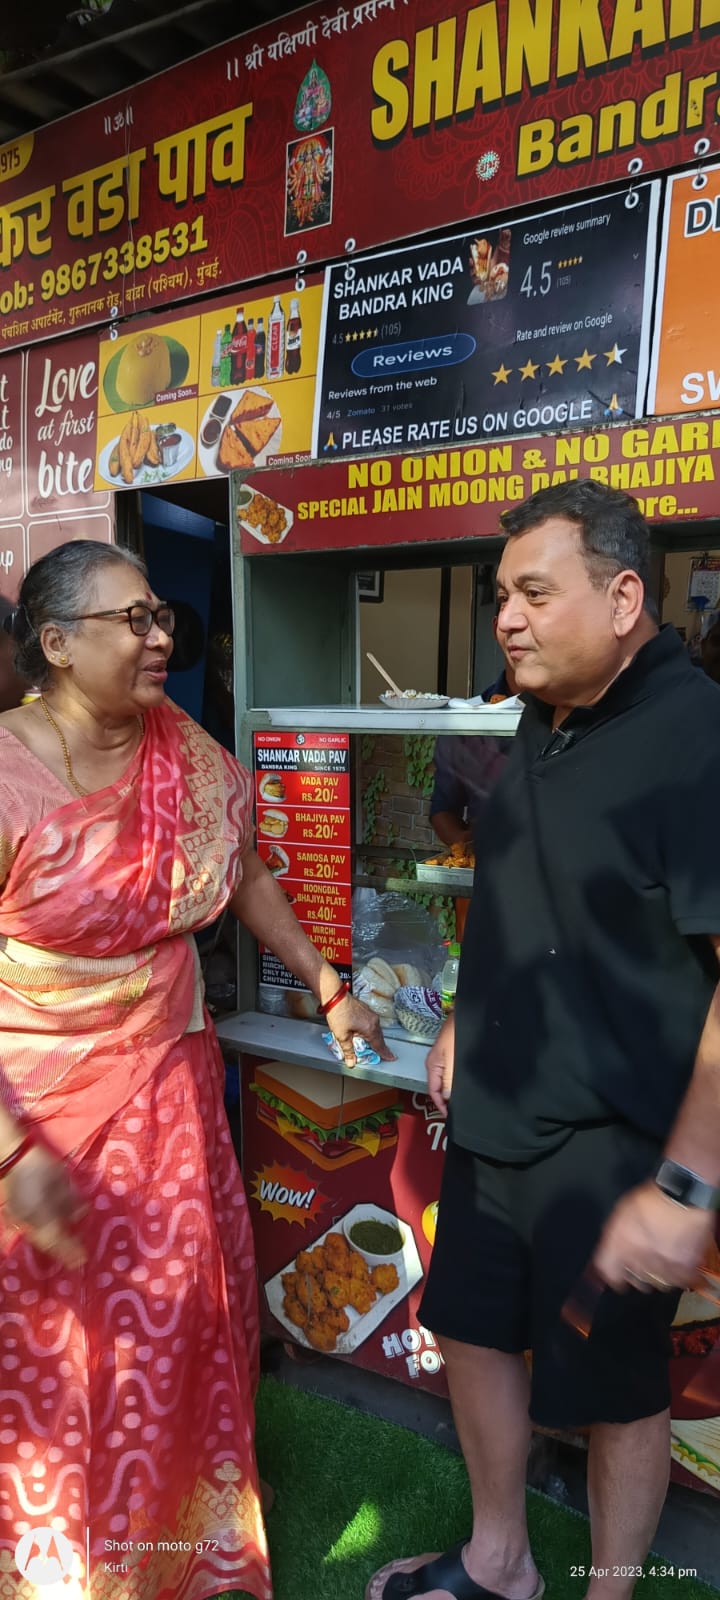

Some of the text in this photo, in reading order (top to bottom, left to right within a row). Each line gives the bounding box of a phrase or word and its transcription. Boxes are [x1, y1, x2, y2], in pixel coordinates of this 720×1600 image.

[244, 42, 264, 71] श्री
[267, 20, 318, 62] यक्षिणी
[320, 7, 350, 39] देवी
[517, 71, 720, 177] Bandr
[62, 147, 147, 238] वडा
[153, 101, 253, 204] पाव
[523, 213, 611, 245] Google review summary
[41, 215, 208, 301] 9867338531
[333, 256, 464, 299] SHANKAR VADA
[520, 261, 553, 298] 4.5
[339, 282, 453, 320] BANDRA KING
[332, 321, 402, 345] 4.5 (105)
[517, 312, 613, 342] Rate and review on Google
[373, 346, 453, 368] Reviews
[35, 358, 98, 418] Love
[156, 391, 177, 402] Coming
[328, 376, 438, 400] Reviews from the web
[326, 409, 341, 420] 4/5
[347, 406, 376, 417] Zomato
[392, 402, 413, 412] votes
[342, 400, 593, 449] PLEASE RATE US ON GOOGLE
[37, 410, 94, 446] at first
[38, 450, 94, 498] bite
[348, 460, 392, 489] NO
[401, 445, 512, 483] ONION
[522, 449, 546, 470] &
[555, 433, 610, 466] NO
[297, 497, 368, 520] SPECIAL
[372, 486, 423, 513] JAIN
[429, 474, 524, 508] MOONG
[590, 454, 715, 491] BHAJIYA
[257, 749, 346, 763] SHANKAR VADA PAV
[300, 776, 339, 786] VADA PAV
[295, 813, 345, 823] BHAJIYA PAV
[297, 852, 345, 864] SAMOSA PAV
[297, 893, 346, 906] BHAJIYA PLATE
[312, 925, 336, 935] MIRCHI
[328, 937, 349, 946] PLATE
[262, 975, 292, 985] CHUTNEY
[427, 1122, 448, 1151] T
[382, 1325, 436, 1358] HOT
[406, 1349, 445, 1378] FO
